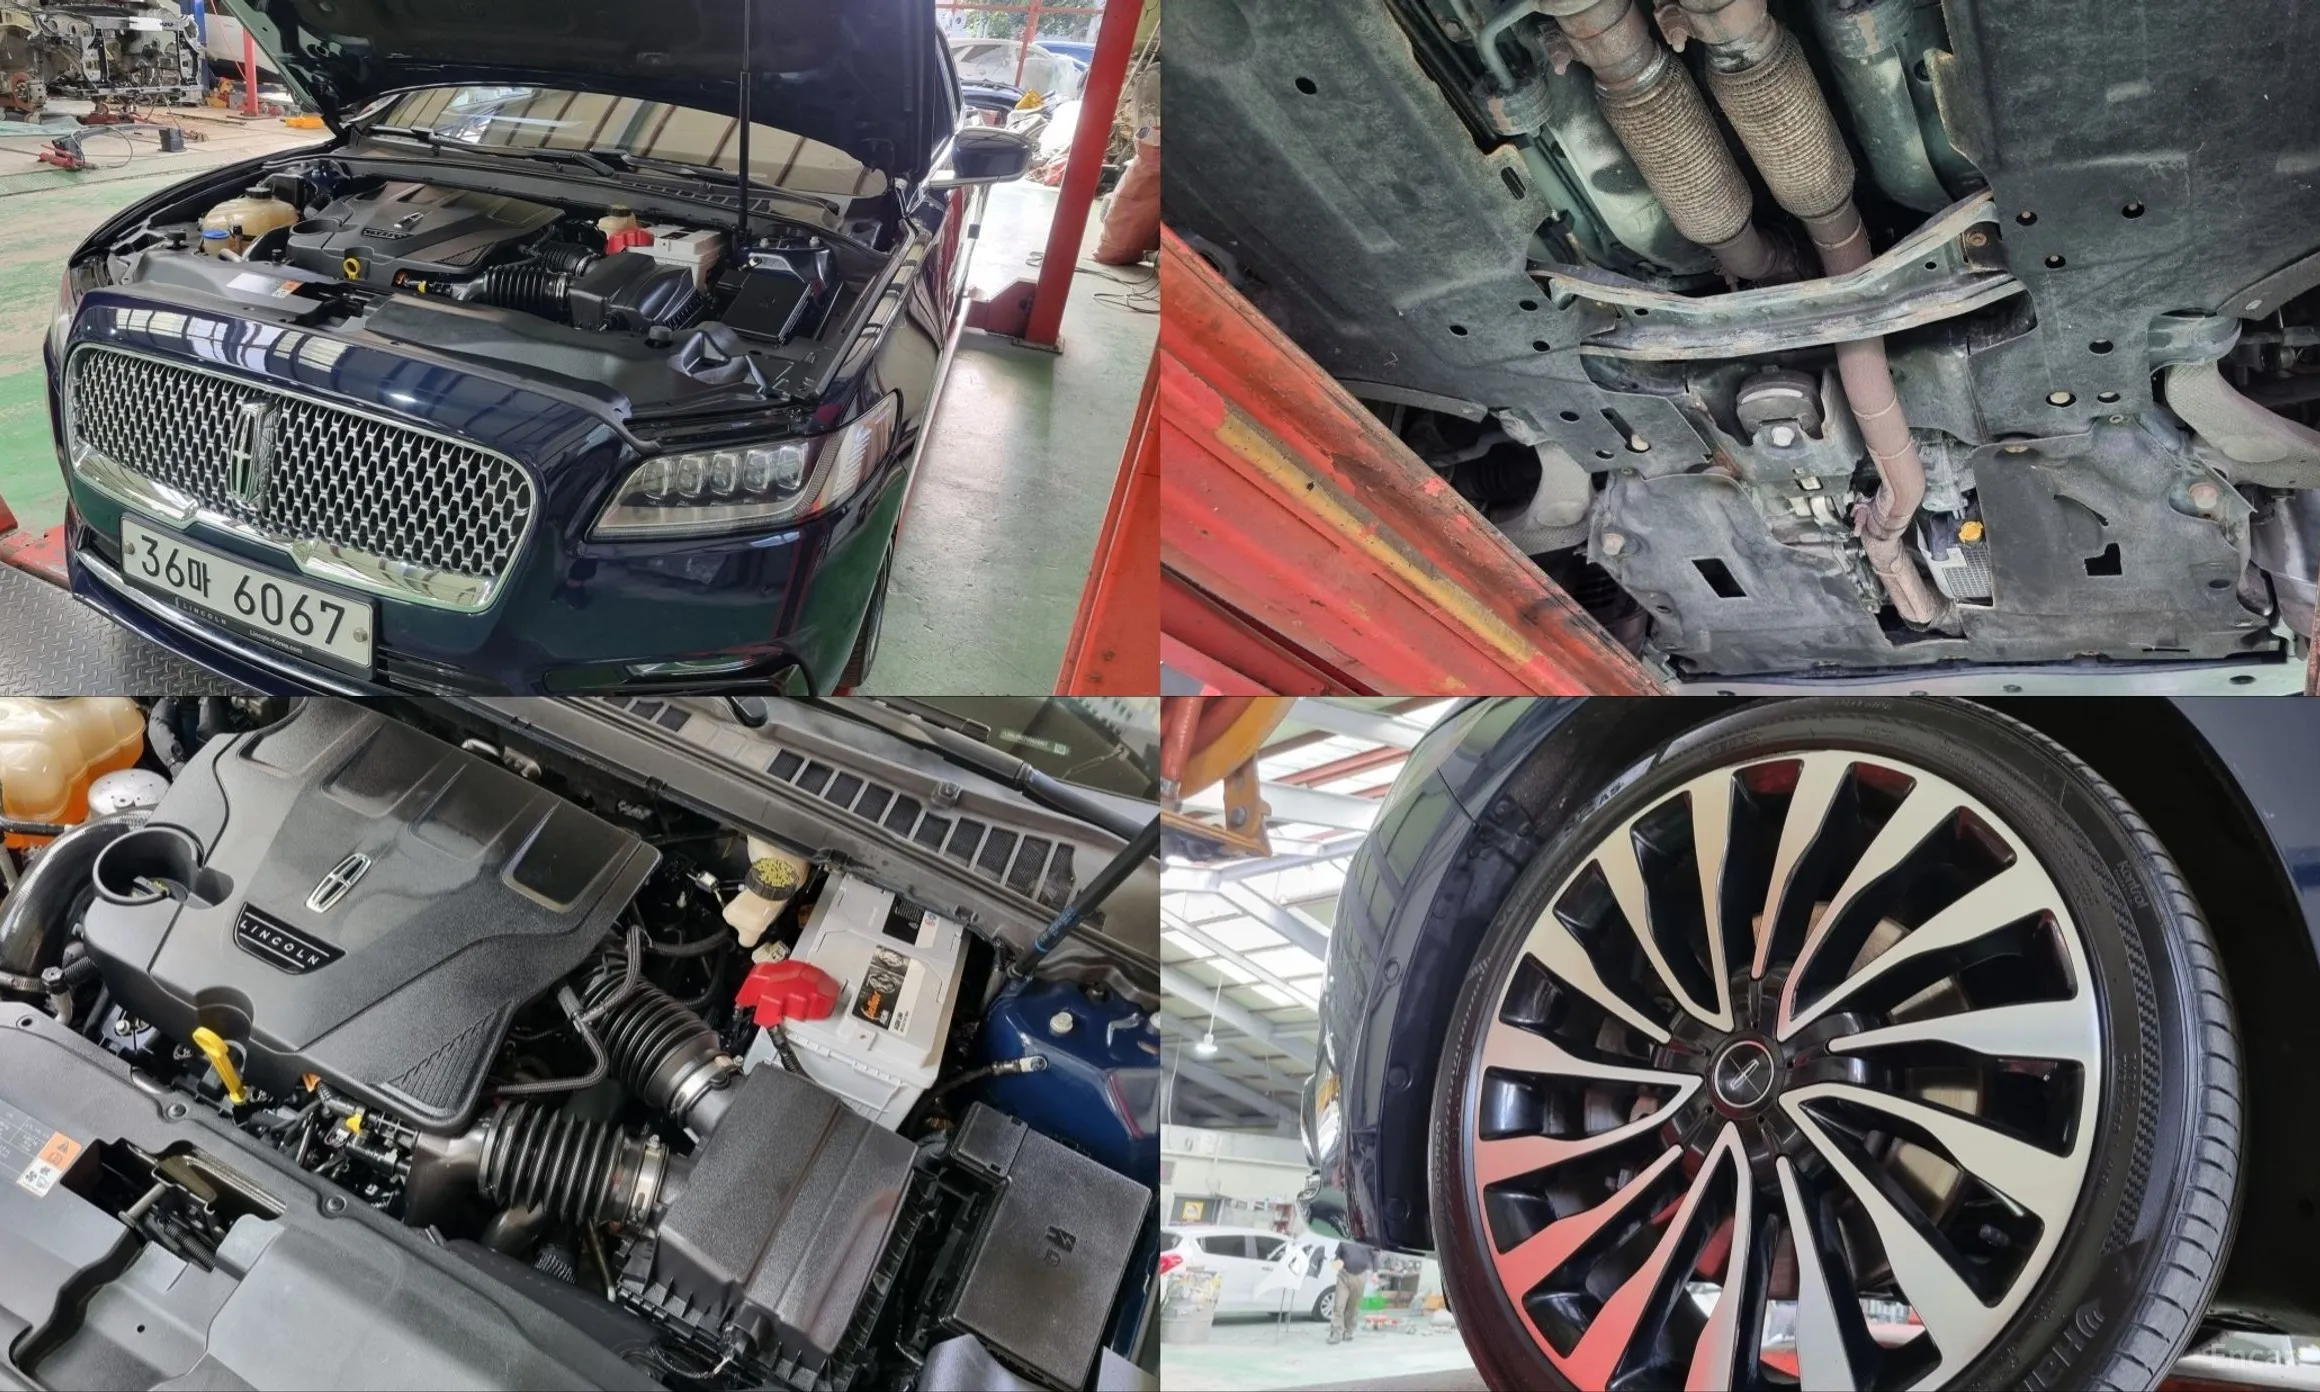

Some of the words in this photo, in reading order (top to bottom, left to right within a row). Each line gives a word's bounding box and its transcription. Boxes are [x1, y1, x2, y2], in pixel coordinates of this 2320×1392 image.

[141, 534, 212, 598] 36마
[233, 575, 345, 645] 6067
[182, 602, 227, 625] LINCOLN
[240, 920, 320, 965] LINCOLN
